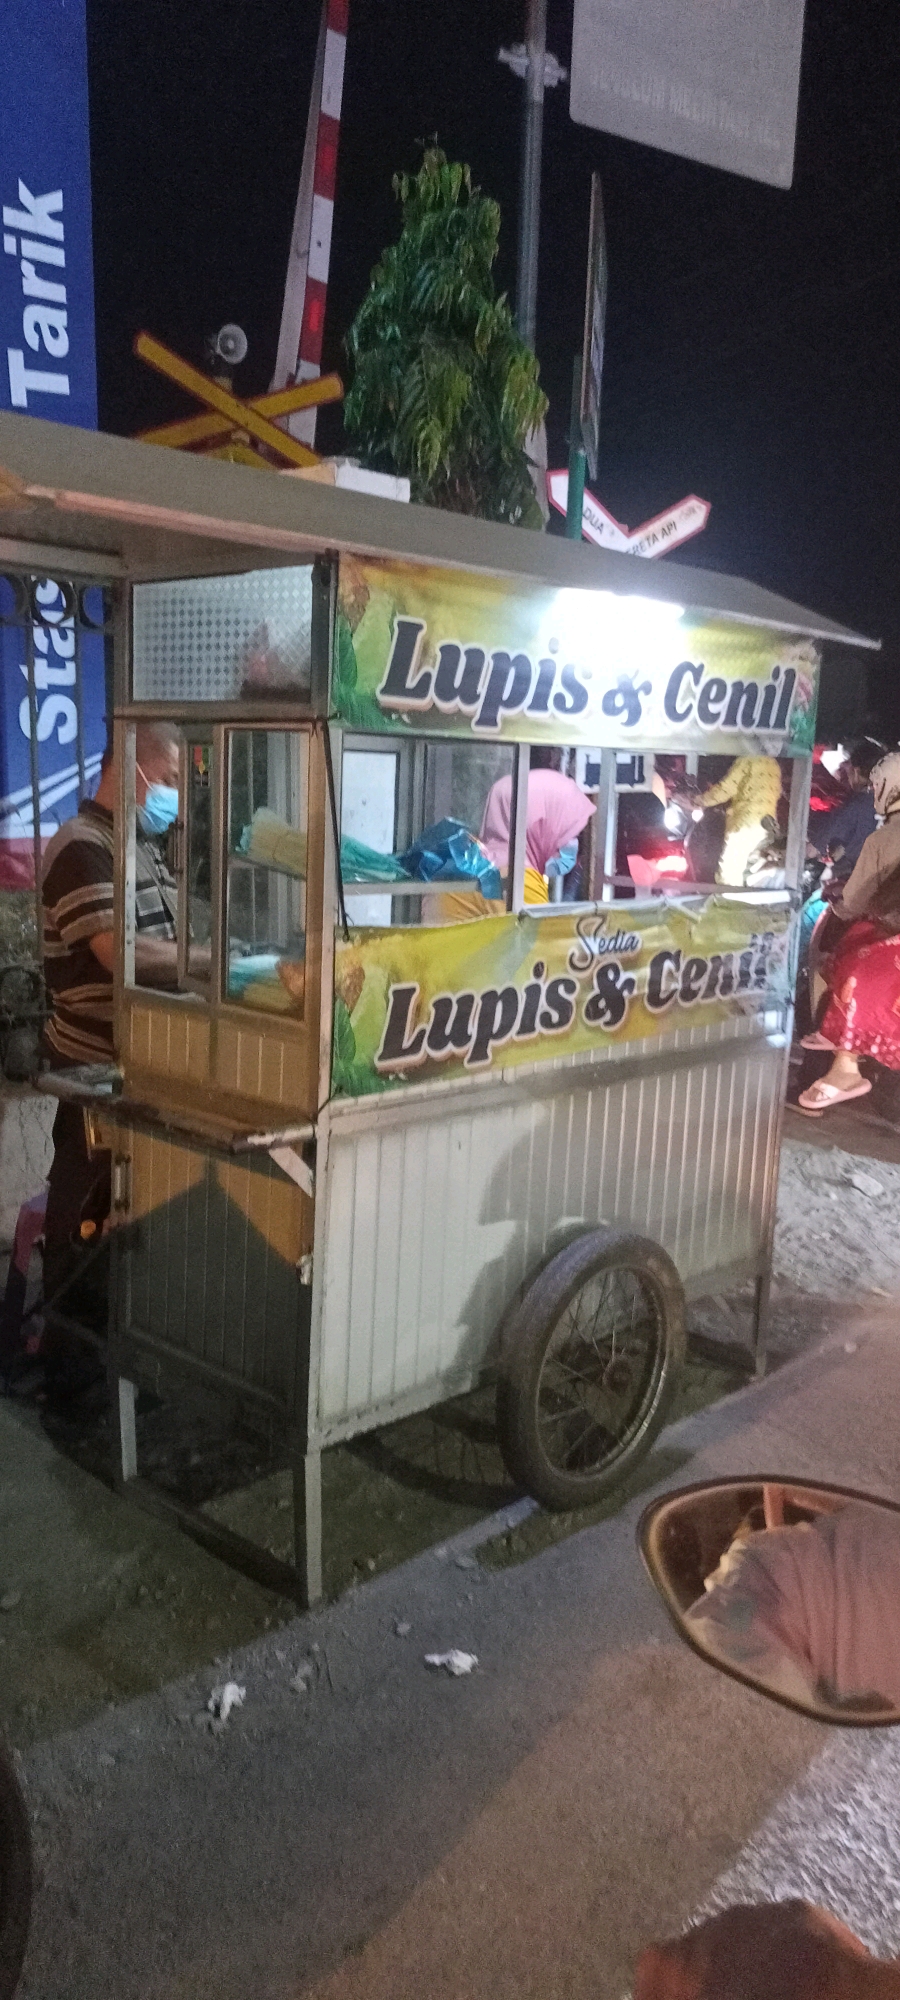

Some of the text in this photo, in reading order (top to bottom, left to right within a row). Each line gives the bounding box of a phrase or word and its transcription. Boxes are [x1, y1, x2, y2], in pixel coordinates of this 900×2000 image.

[3, 177, 70, 408] Tarik
[582, 507, 604, 535] DUA
[661, 520, 678, 539] API
[379, 621, 797, 730] Lupis & Cenil
[569, 914, 640, 972] Sedia
[375, 931, 775, 1065] Lupis & Cenil
